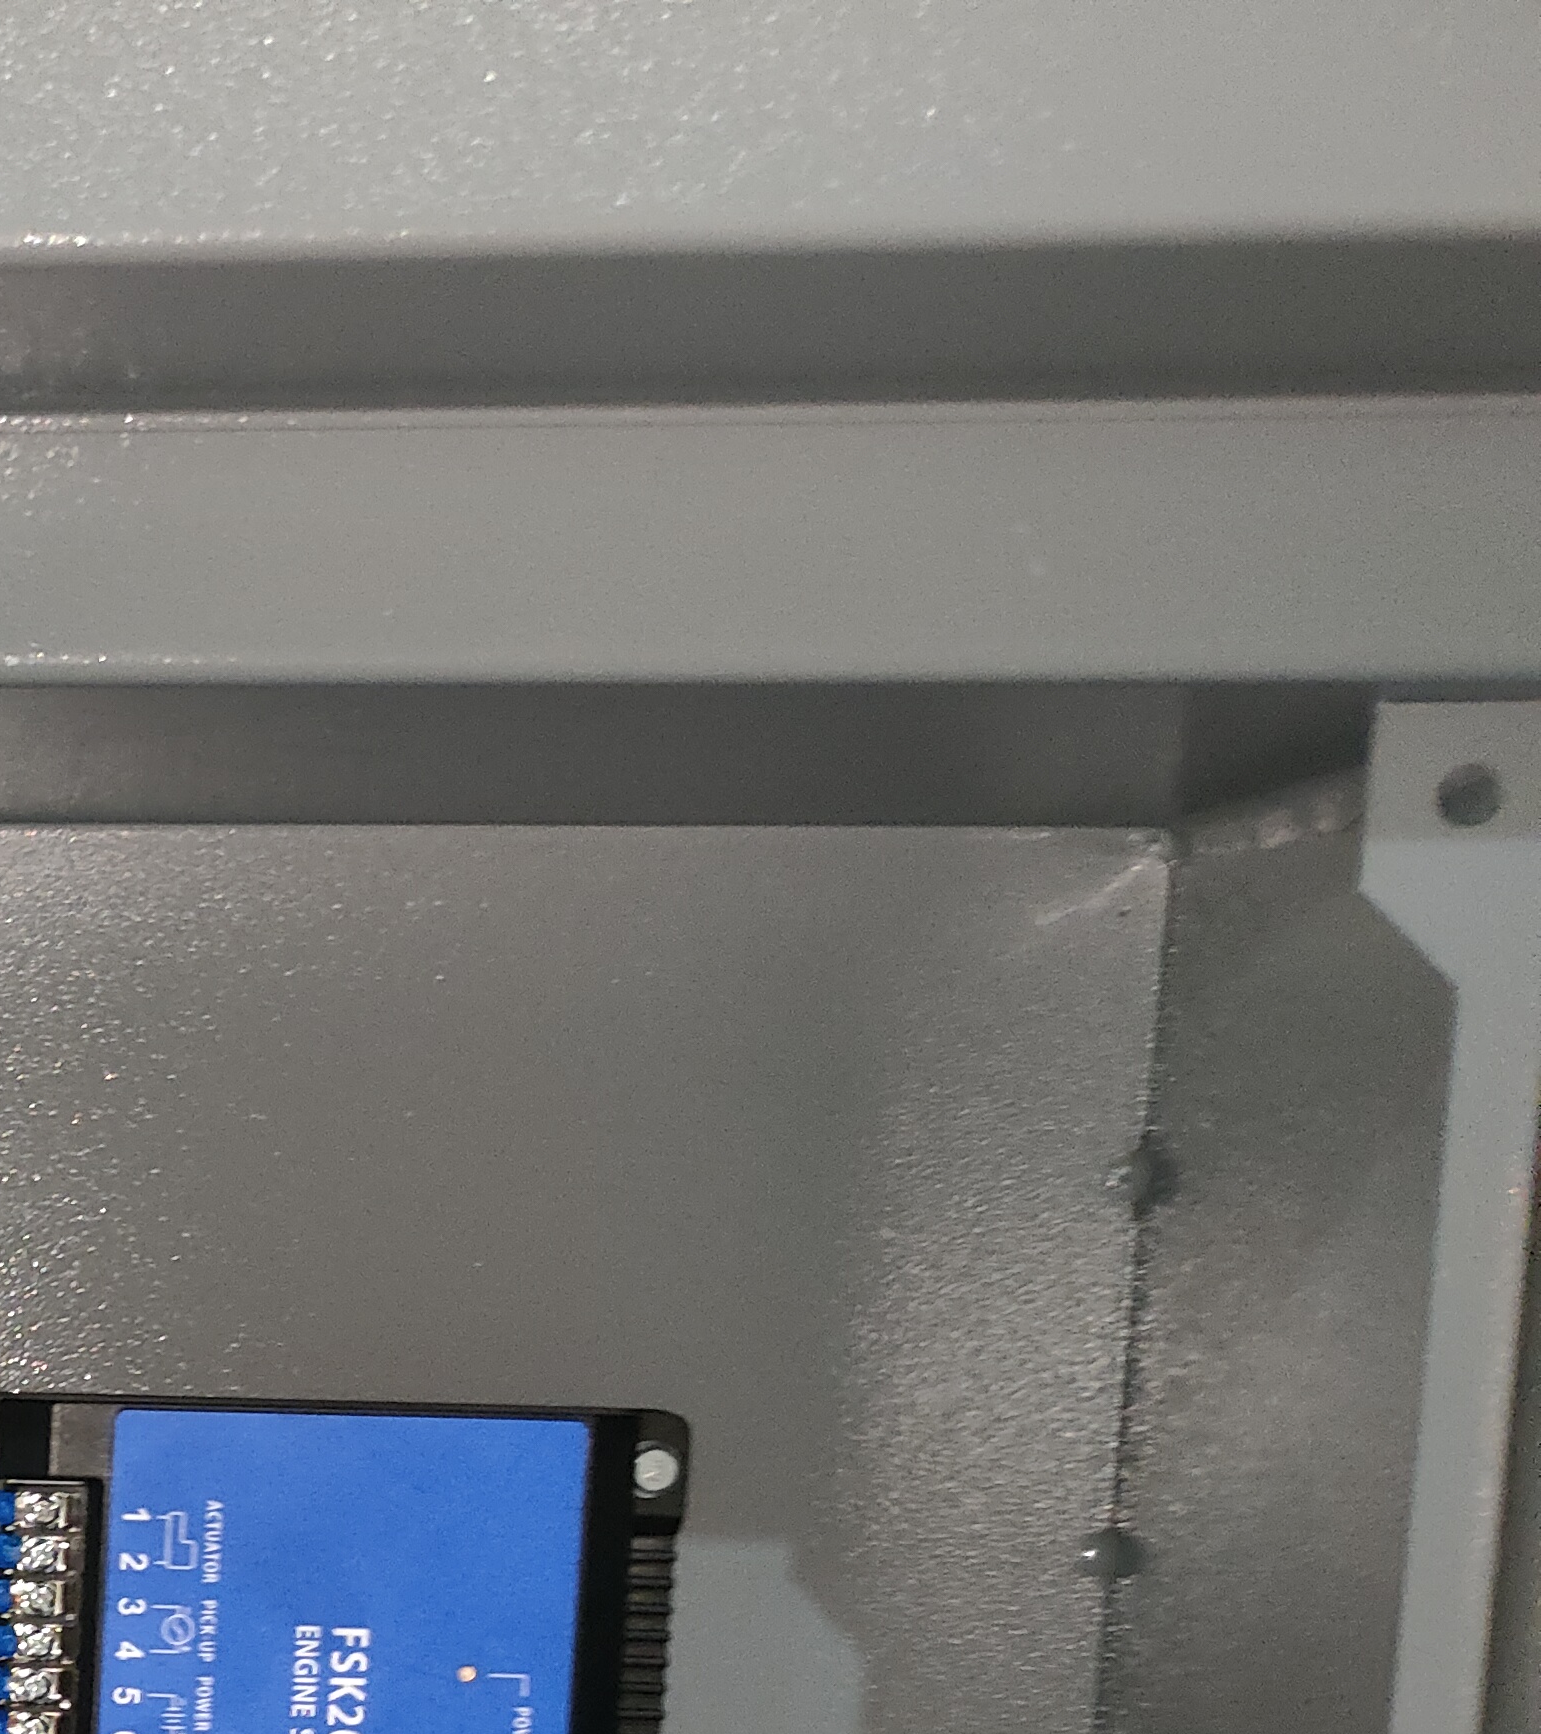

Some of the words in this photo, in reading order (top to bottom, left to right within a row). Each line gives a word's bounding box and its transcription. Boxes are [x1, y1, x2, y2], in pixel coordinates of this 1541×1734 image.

[122, 1509, 151, 1520] 1
[203, 1501, 223, 1582] ACTUATOR
[119, 1553, 149, 1570] 2
[118, 1598, 146, 1615] 3
[115, 1641, 144, 1660] 4
[291, 1626, 321, 1716] ENGINE
[113, 1687, 141, 1704] 5
[194, 1677, 213, 1730] POWER
